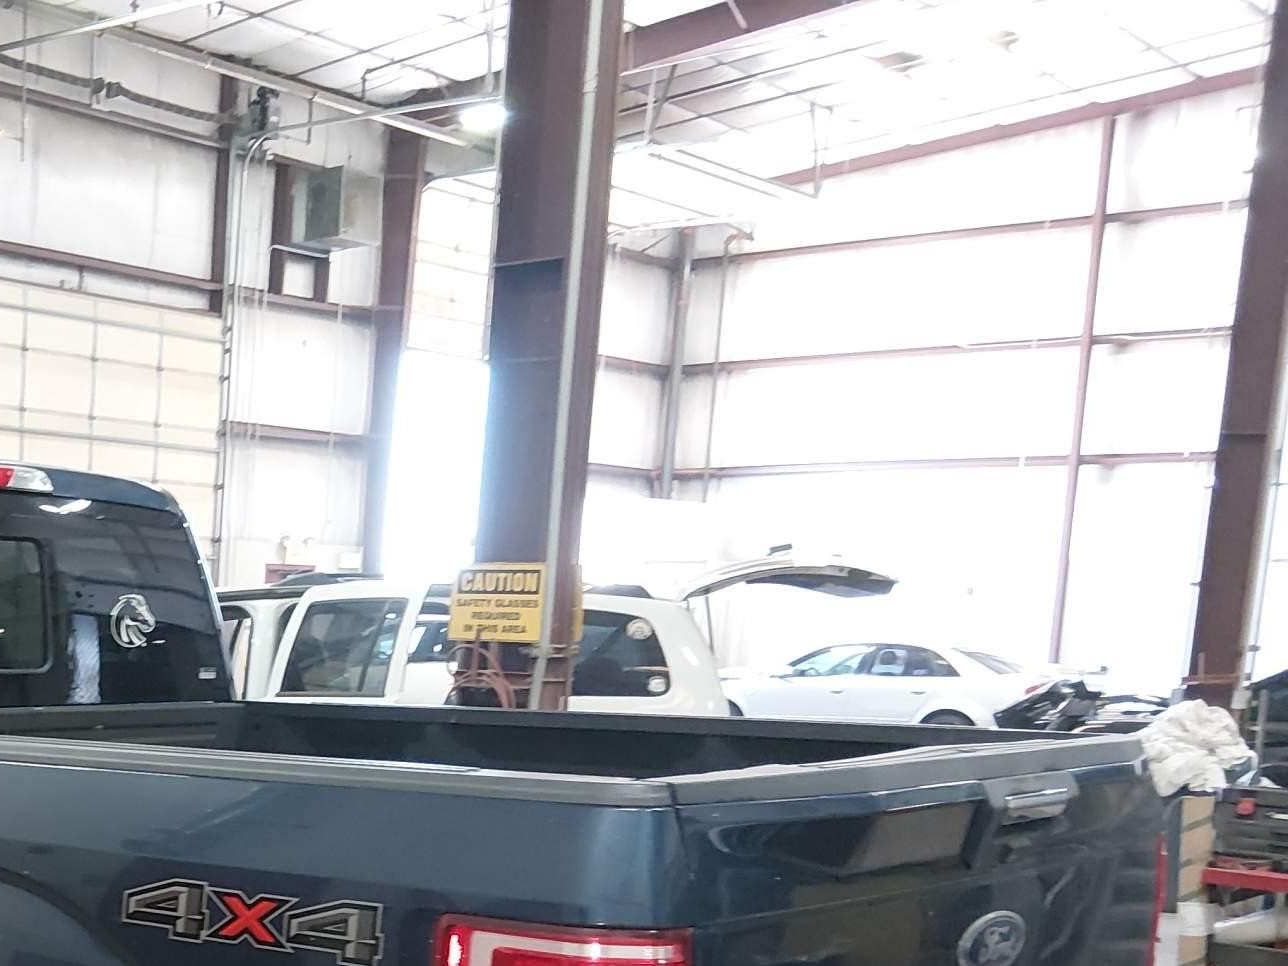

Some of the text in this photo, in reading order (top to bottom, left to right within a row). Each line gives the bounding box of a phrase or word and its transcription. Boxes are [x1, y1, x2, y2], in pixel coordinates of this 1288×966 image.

[461, 572, 539, 592] CAUTION
[456, 598, 539, 608] SAFETY GLASSES
[471, 611, 520, 620] REQUIRED
[502, 624, 527, 633] AREA
